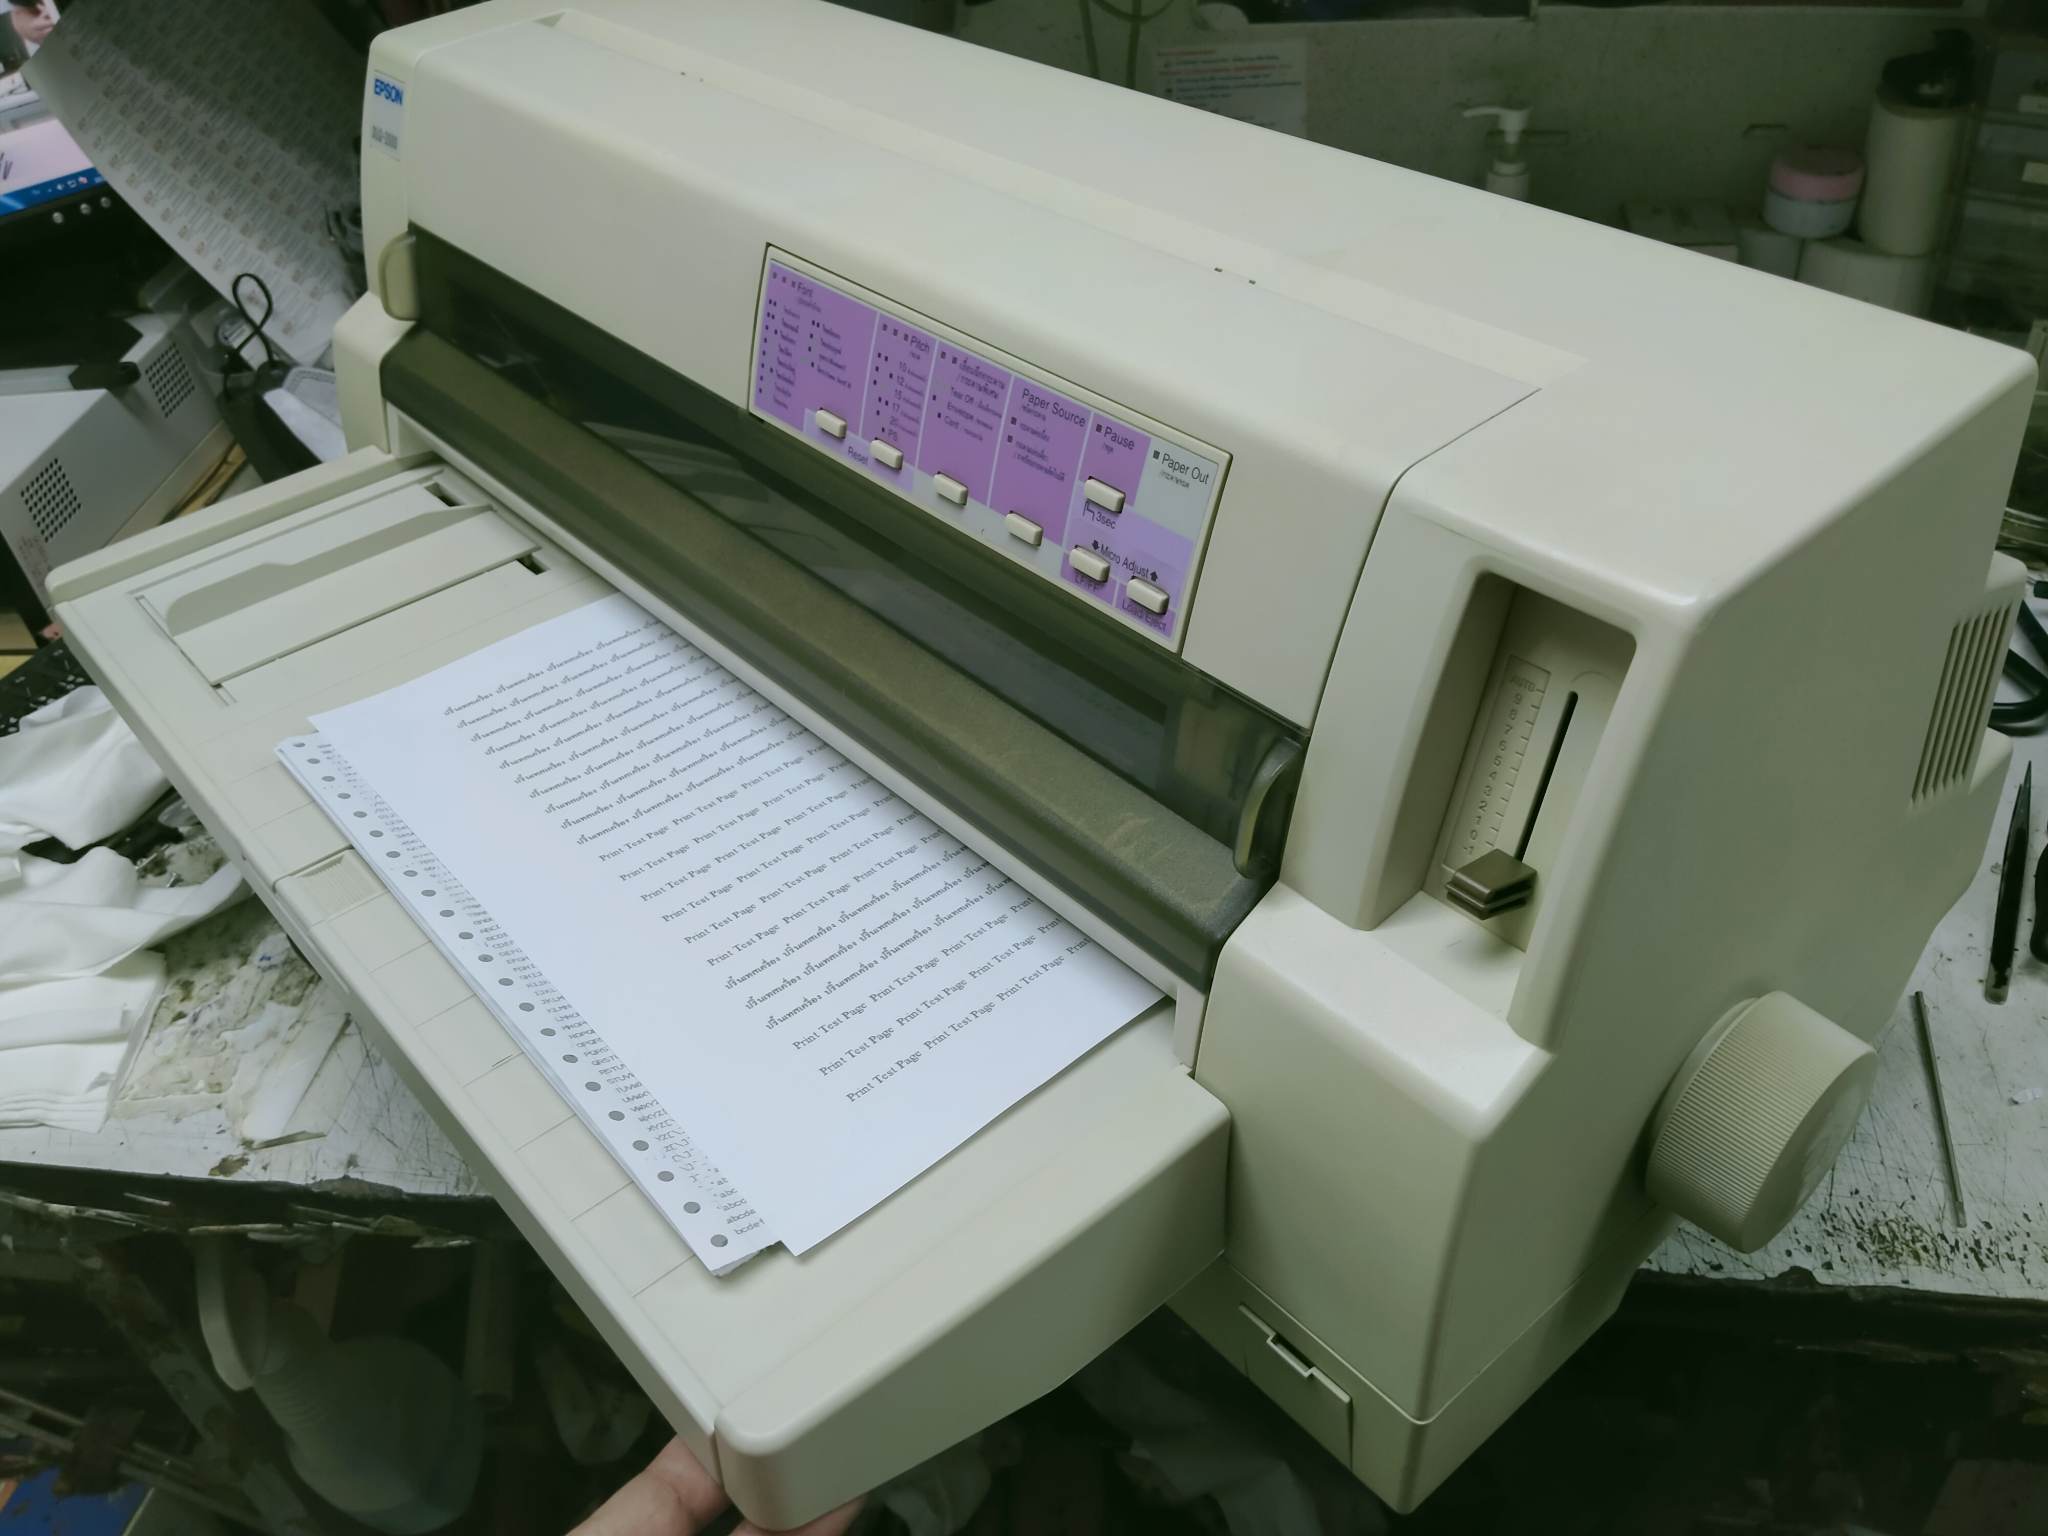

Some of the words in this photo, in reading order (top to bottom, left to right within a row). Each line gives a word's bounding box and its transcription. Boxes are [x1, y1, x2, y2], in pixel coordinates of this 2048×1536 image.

[374, 78, 404, 106] EPSON
[910, 336, 930, 354] Pitch
[1022, 388, 1050, 411] Paper
[1052, 402, 1086, 428] Source
[1104, 426, 1135, 450] Pause
[1162, 453, 1189, 476] Paper
[1191, 466, 1209, 484] Out
[1095, 511, 1116, 529] 3sec
[1100, 544, 1120, 564] Micro
[1122, 557, 1149, 579] Adjust
[598, 848, 624, 862] Print
[623, 838, 646, 850] Test
[645, 825, 669, 839] Page
[672, 812, 696, 826] Print
[695, 801, 717, 813] Test
[715, 790, 738, 803] Page
[619, 867, 645, 881] Print
[643, 857, 667, 869] Test
[666, 844, 690, 858] Page
[691, 830, 718, 844] Print
[717, 818, 738, 831] Test
[737, 808, 760, 821] Page
[640, 888, 666, 902] Print
[665, 876, 688, 889] Test
[687, 864, 712, 878] Page
[714, 848, 739, 863] Print
[737, 837, 760, 850] Test
[757, 826, 782, 840] Page
[784, 812, 808, 826] Print
[806, 801, 829, 813] Test
[824, 791, 848, 803] Page
[661, 908, 688, 922] Print
[686, 896, 710, 908] Test
[708, 884, 734, 898] Page
[736, 868, 761, 883] Print
[759, 856, 782, 869] Test
[780, 844, 805, 858] Page
[805, 830, 830, 844] Print
[828, 819, 850, 830] Test
[848, 808, 870, 821] Page
[683, 929, 711, 944] Print
[709, 917, 733, 930] Test
[731, 904, 757, 920] Page
[758, 888, 784, 903] Print
[782, 876, 806, 888] Test
[803, 864, 828, 877] Page
[829, 848, 853, 863] Print
[851, 838, 874, 850] Test
[871, 826, 894, 839] Page
[707, 950, 734, 966] Print
[731, 938, 757, 952] Test
[754, 924, 780, 940] Page
[782, 908, 809, 924] Print
[806, 896, 829, 909] Test
[826, 883, 851, 898] Page
[852, 867, 878, 883] Print
[874, 856, 898, 870] Test
[894, 845, 919, 858] Page
[792, 1031, 821, 1050] Print
[818, 1017, 844, 1034] Test
[840, 1002, 867, 1020] Page
[868, 983, 896, 1002] Print
[893, 971, 917, 986] Test
[914, 957, 940, 974] Page
[940, 940, 969, 957] Print
[963, 927, 987, 941] Test
[984, 914, 1008, 929] Page
[818, 1057, 847, 1076] Print
[844, 1042, 870, 1058] Test
[867, 1028, 894, 1045] Page
[896, 1008, 923, 1026] Print
[920, 991, 944, 1009] Test
[940, 980, 967, 996] Page
[968, 962, 994, 979] Print
[991, 949, 1015, 963] Test
[1012, 935, 1036, 951] Page
[845, 1083, 875, 1102] Print
[872, 1066, 898, 1084] Test
[894, 1051, 922, 1070] Page
[923, 1030, 951, 1050] Print
[948, 1016, 973, 1032] Test
[969, 1002, 996, 1019] Page
[995, 984, 1023, 1002] Print
[1019, 970, 1044, 984] Test
[1040, 956, 1064, 972] Page
